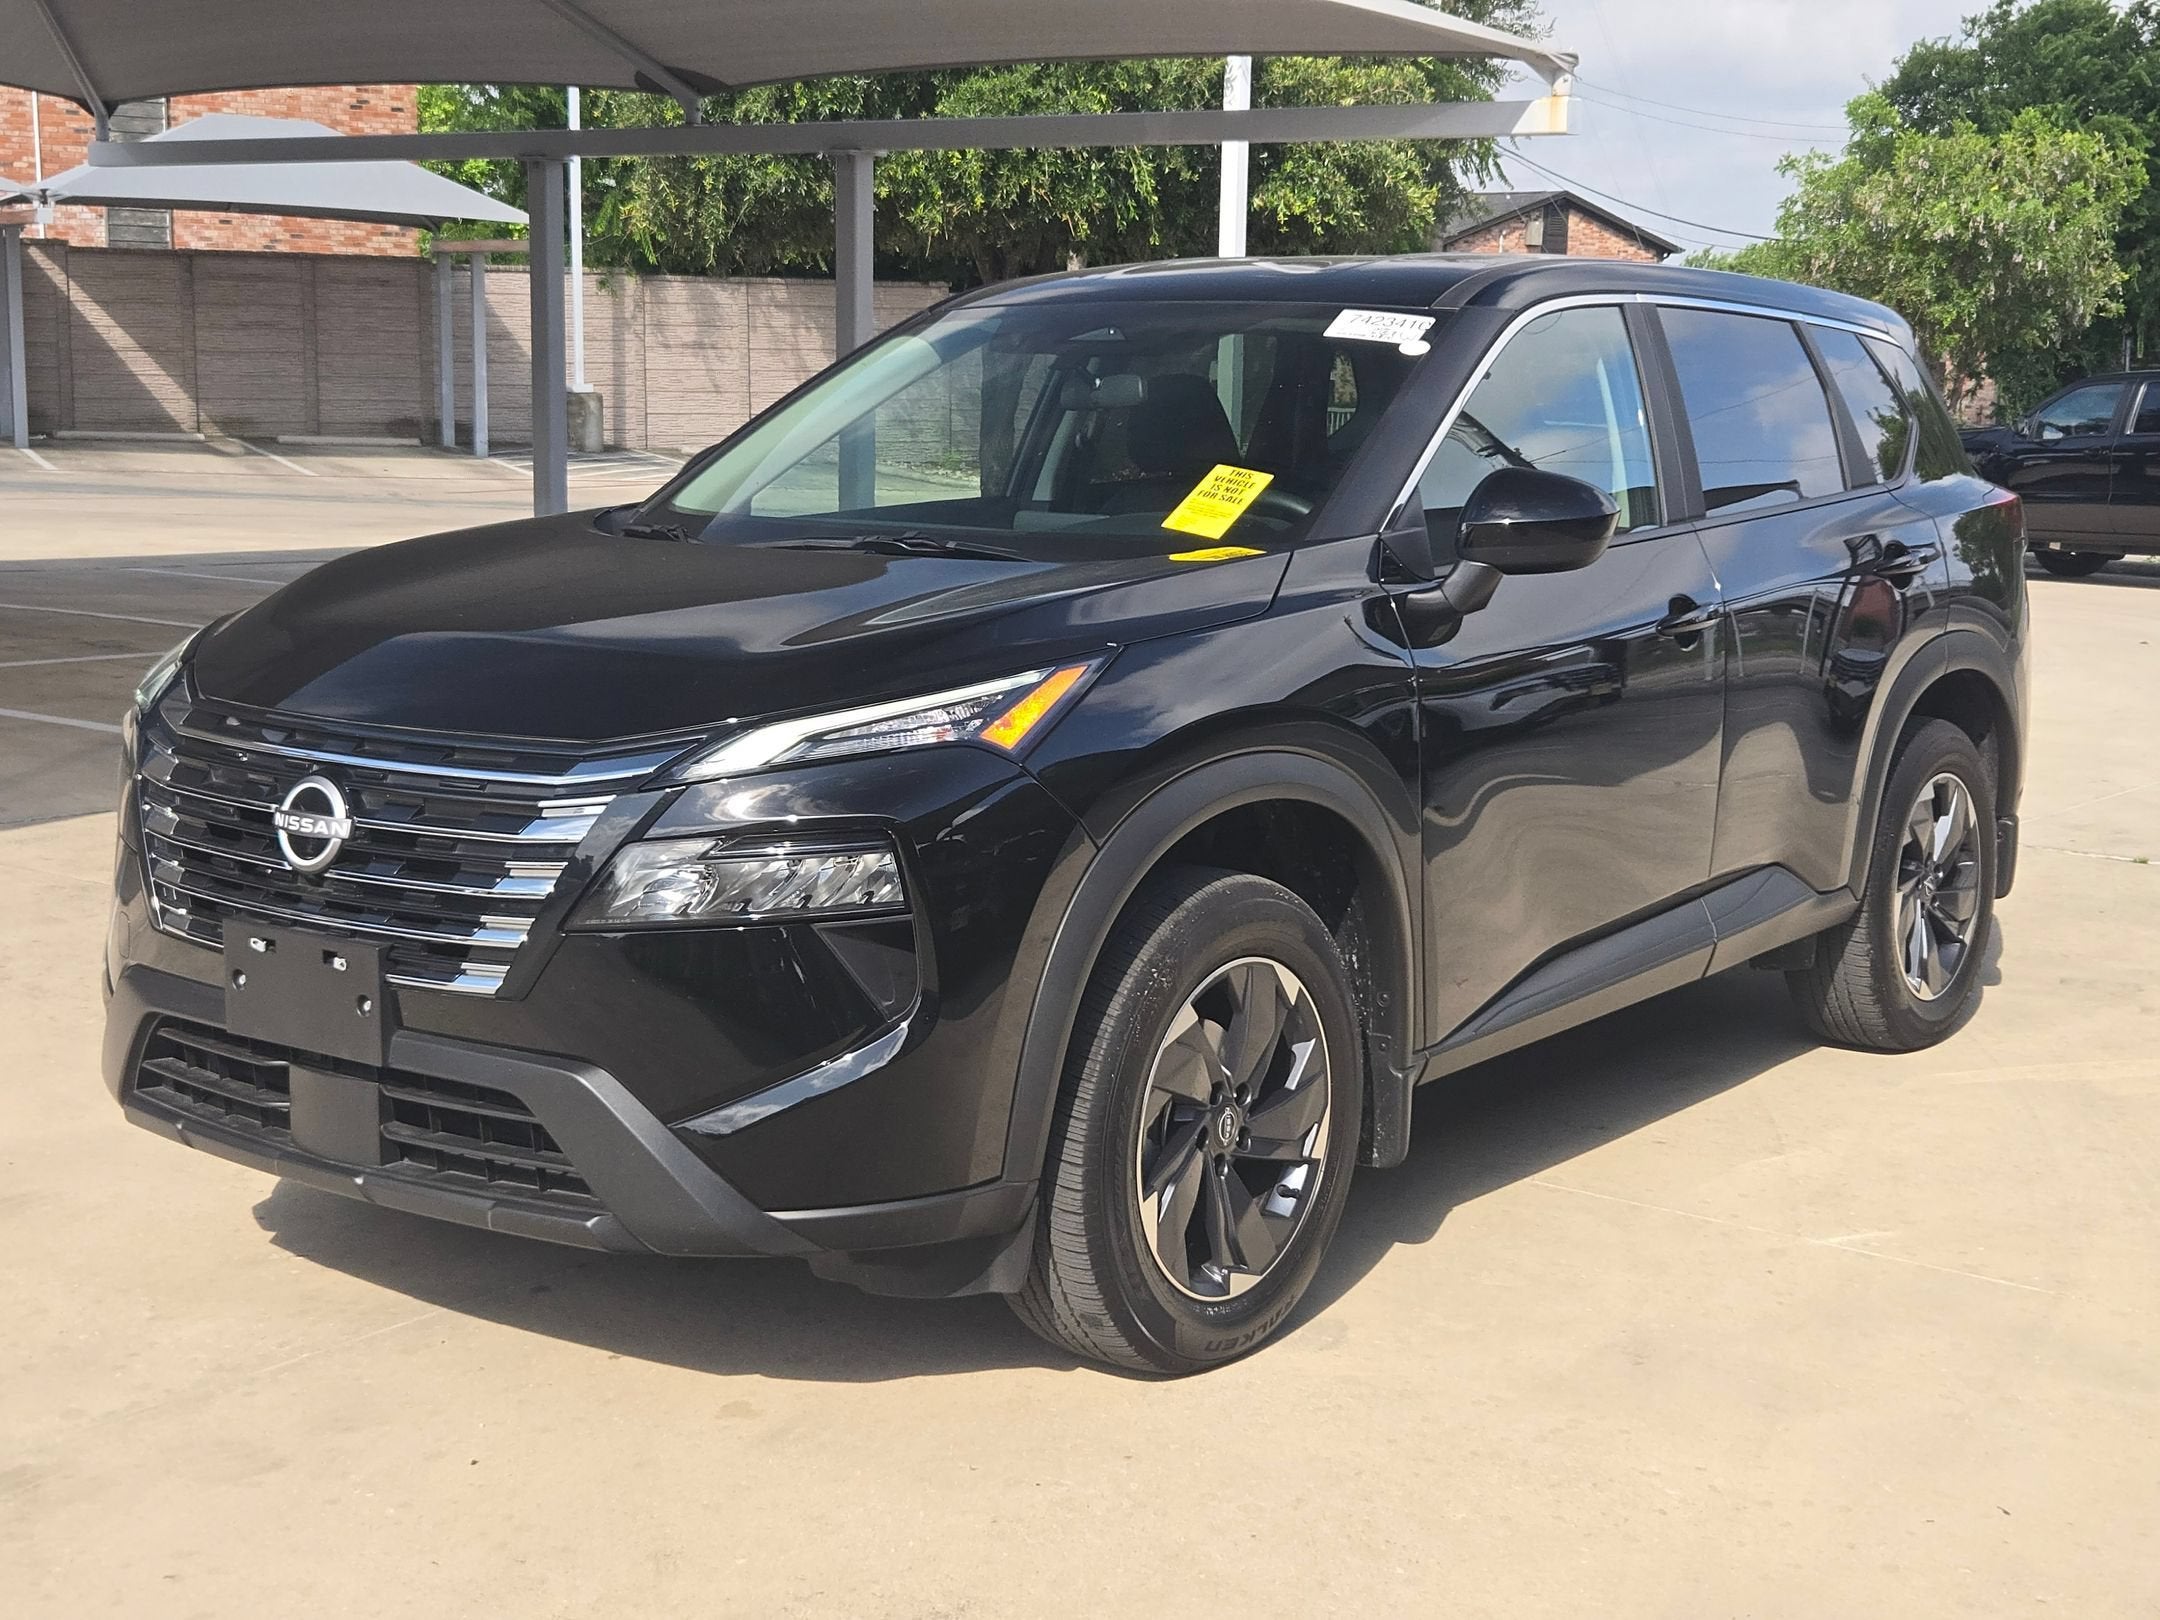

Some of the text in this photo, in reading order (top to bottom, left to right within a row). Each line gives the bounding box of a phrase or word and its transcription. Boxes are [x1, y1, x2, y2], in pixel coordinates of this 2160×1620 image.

[1229, 469, 1254, 480] THIS
[1215, 475, 1256, 489] VEHICLE
[1210, 483, 1246, 496] IS NOT
[1197, 490, 1243, 505] FOR SALE
[274, 811, 348, 837] NISSAN
